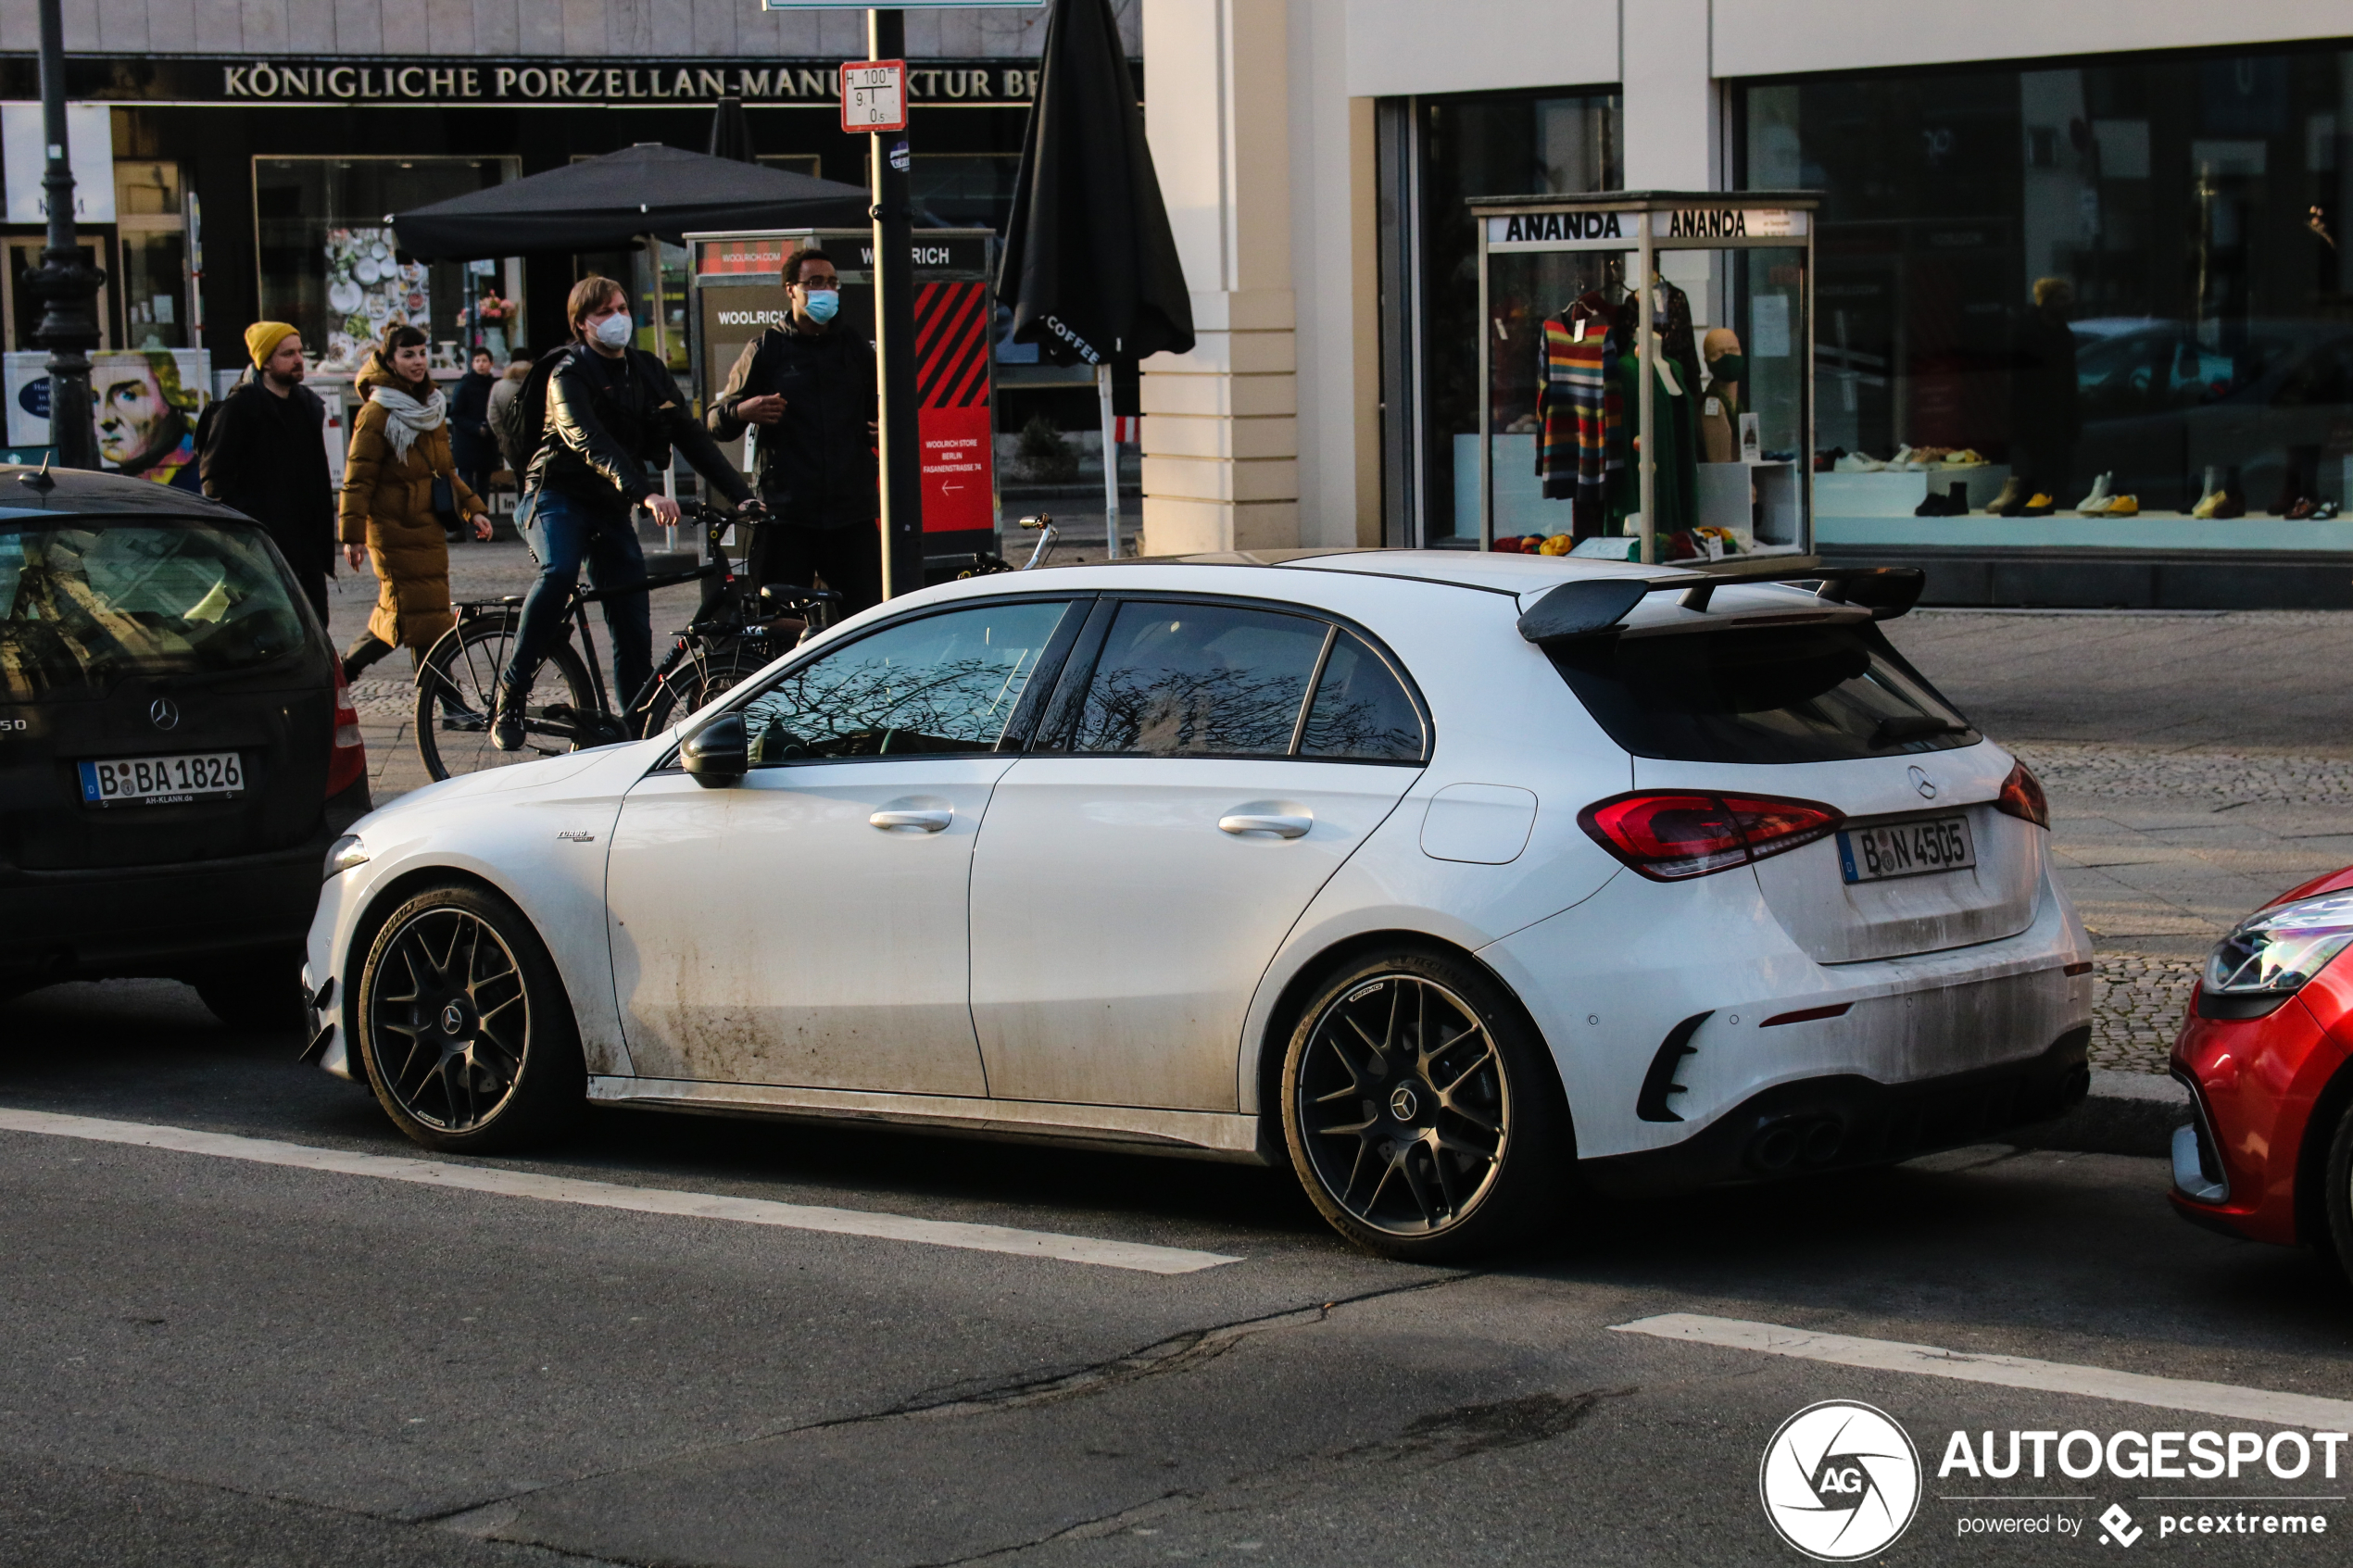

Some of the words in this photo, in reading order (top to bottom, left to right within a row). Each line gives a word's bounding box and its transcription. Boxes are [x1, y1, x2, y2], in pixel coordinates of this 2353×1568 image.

[223, 62, 482, 97] KÖNIGLICHE
[846, 71, 854, 85] H
[864, 69, 887, 84] 100
[1505, 212, 1622, 242] ANANDA
[1670, 209, 1747, 238] ANANDA
[723, 252, 781, 263] WOOLRICH.COM
[861, 246, 950, 265] WRICH
[1047, 315, 1101, 365] COFFEE
[925, 439, 959, 449] WOOLRICH
[959, 438, 978, 447] STORE
[941, 451, 963, 461] BERLIN
[98, 764, 119, 797] B
[134, 760, 172, 793] BA
[175, 757, 240, 790] 1826
[145, 794, 194, 805] AH-KLANN.de
[1861, 834, 1881, 872] B
[1891, 830, 1912, 869] N
[1914, 823, 1965, 866] 4505
